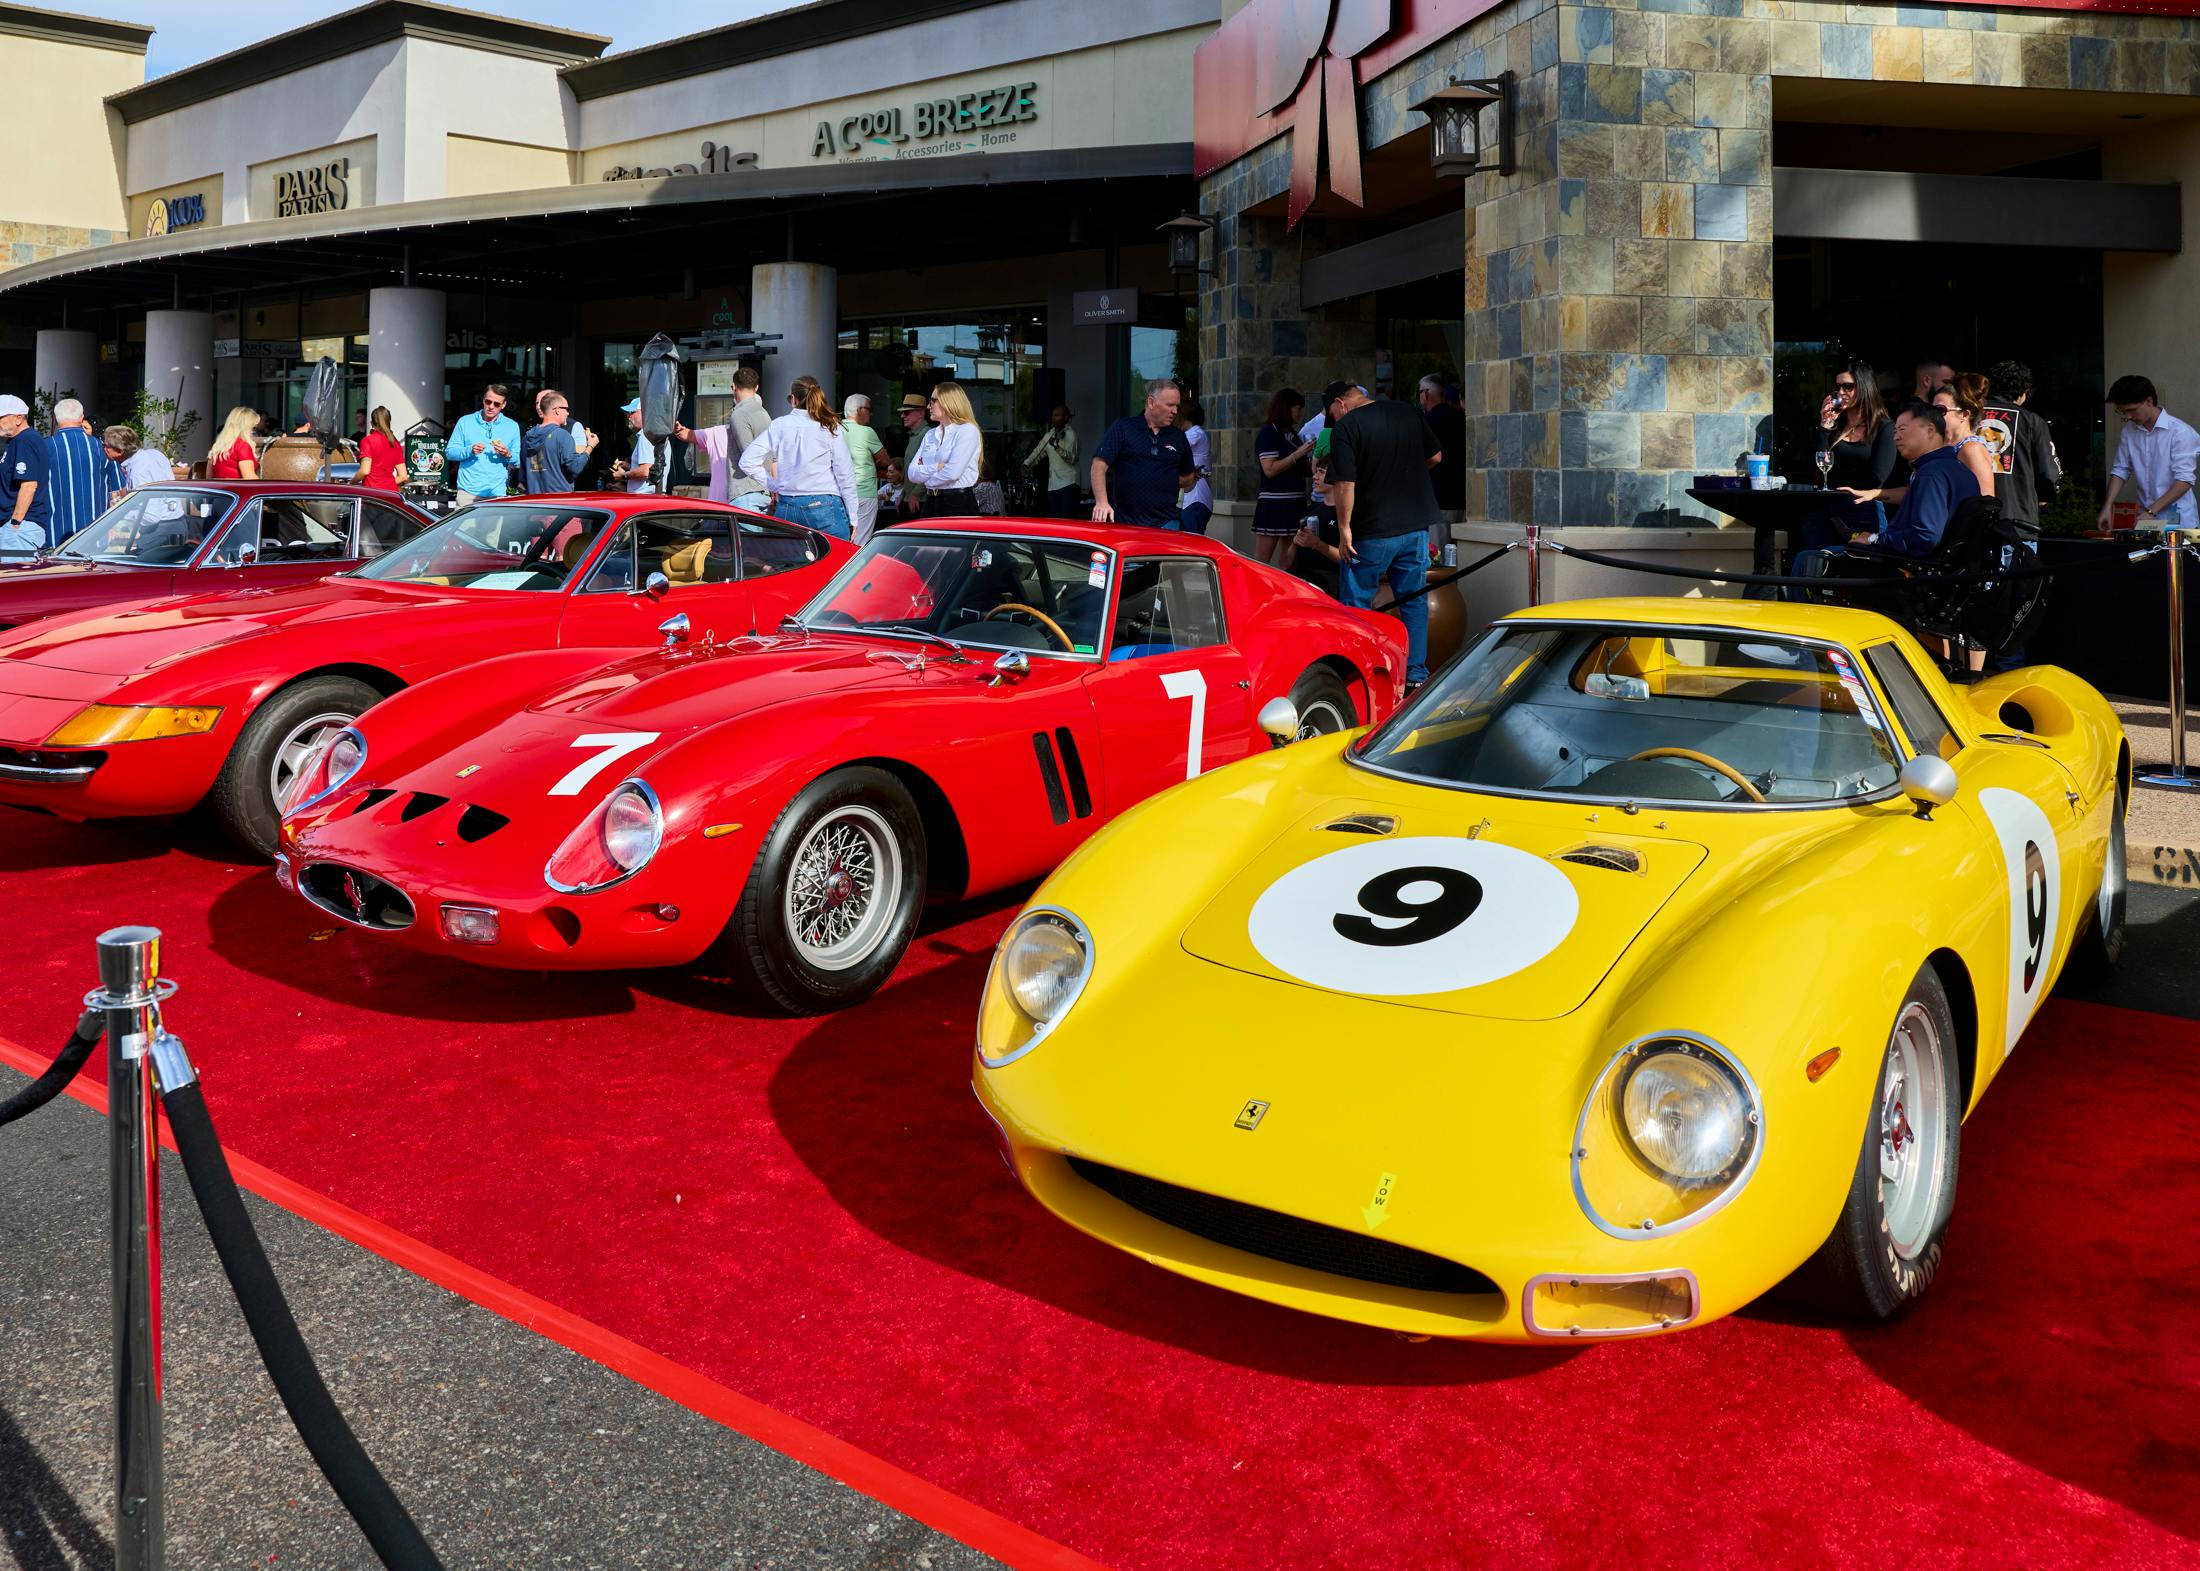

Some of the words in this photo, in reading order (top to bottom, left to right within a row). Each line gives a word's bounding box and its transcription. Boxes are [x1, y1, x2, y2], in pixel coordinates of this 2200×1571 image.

[811, 121, 836, 157] A
[838, 107, 909, 151] COOL
[914, 81, 1038, 139] BREEZE
[895, 140, 962, 161] Accessories
[981, 131, 1017, 147] Home
[273, 157, 349, 217] PARIS
[712, 312, 736, 326] COOL
[1106, 309, 1125, 317] SMITH
[1159, 668, 1207, 780] 7
[547, 732, 662, 796] 7
[1332, 866, 1484, 947] 9
[2024, 839, 2047, 994] 9
[1375, 1178, 1392, 1206] TOW
